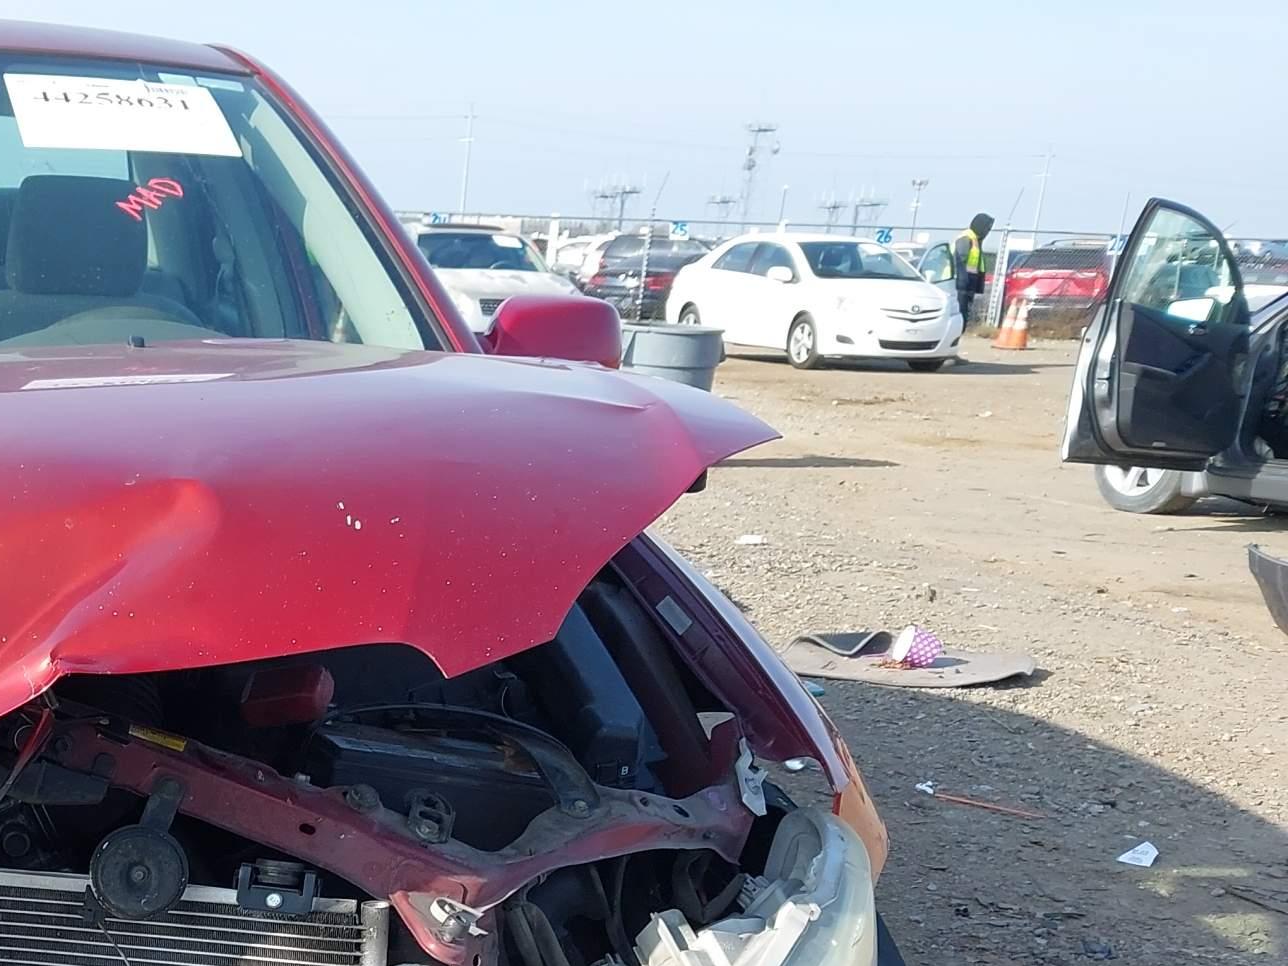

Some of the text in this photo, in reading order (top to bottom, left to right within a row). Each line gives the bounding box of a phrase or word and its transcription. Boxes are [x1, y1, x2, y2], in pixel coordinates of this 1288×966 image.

[32, 91, 191, 111] 44258631
[671, 221, 687, 236] 25
[876, 227, 892, 244] 26
